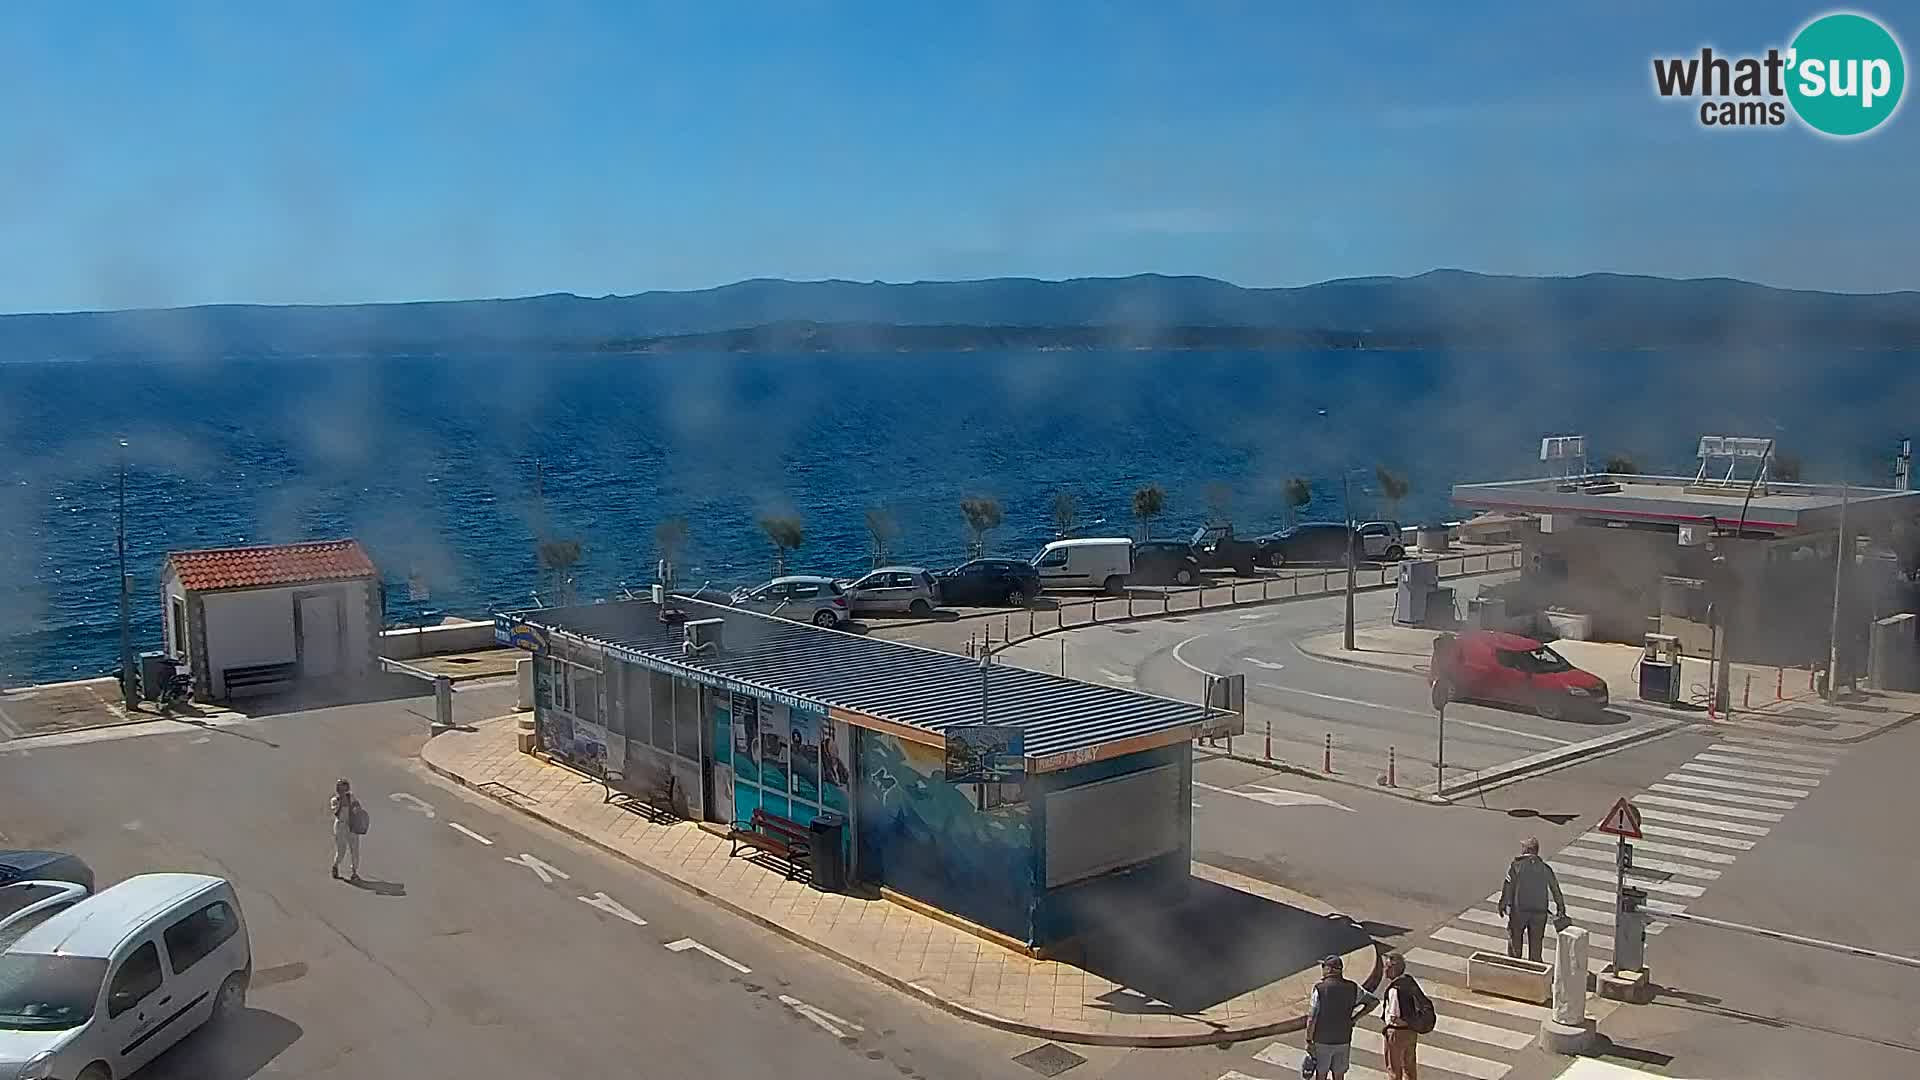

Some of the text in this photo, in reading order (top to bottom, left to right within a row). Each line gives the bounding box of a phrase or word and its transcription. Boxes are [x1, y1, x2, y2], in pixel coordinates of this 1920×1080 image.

[726, 680, 741, 692] BUS
[742, 684, 772, 701] STATION
[774, 692, 798, 707] TICKET
[799, 699, 826, 714] OFFICE
